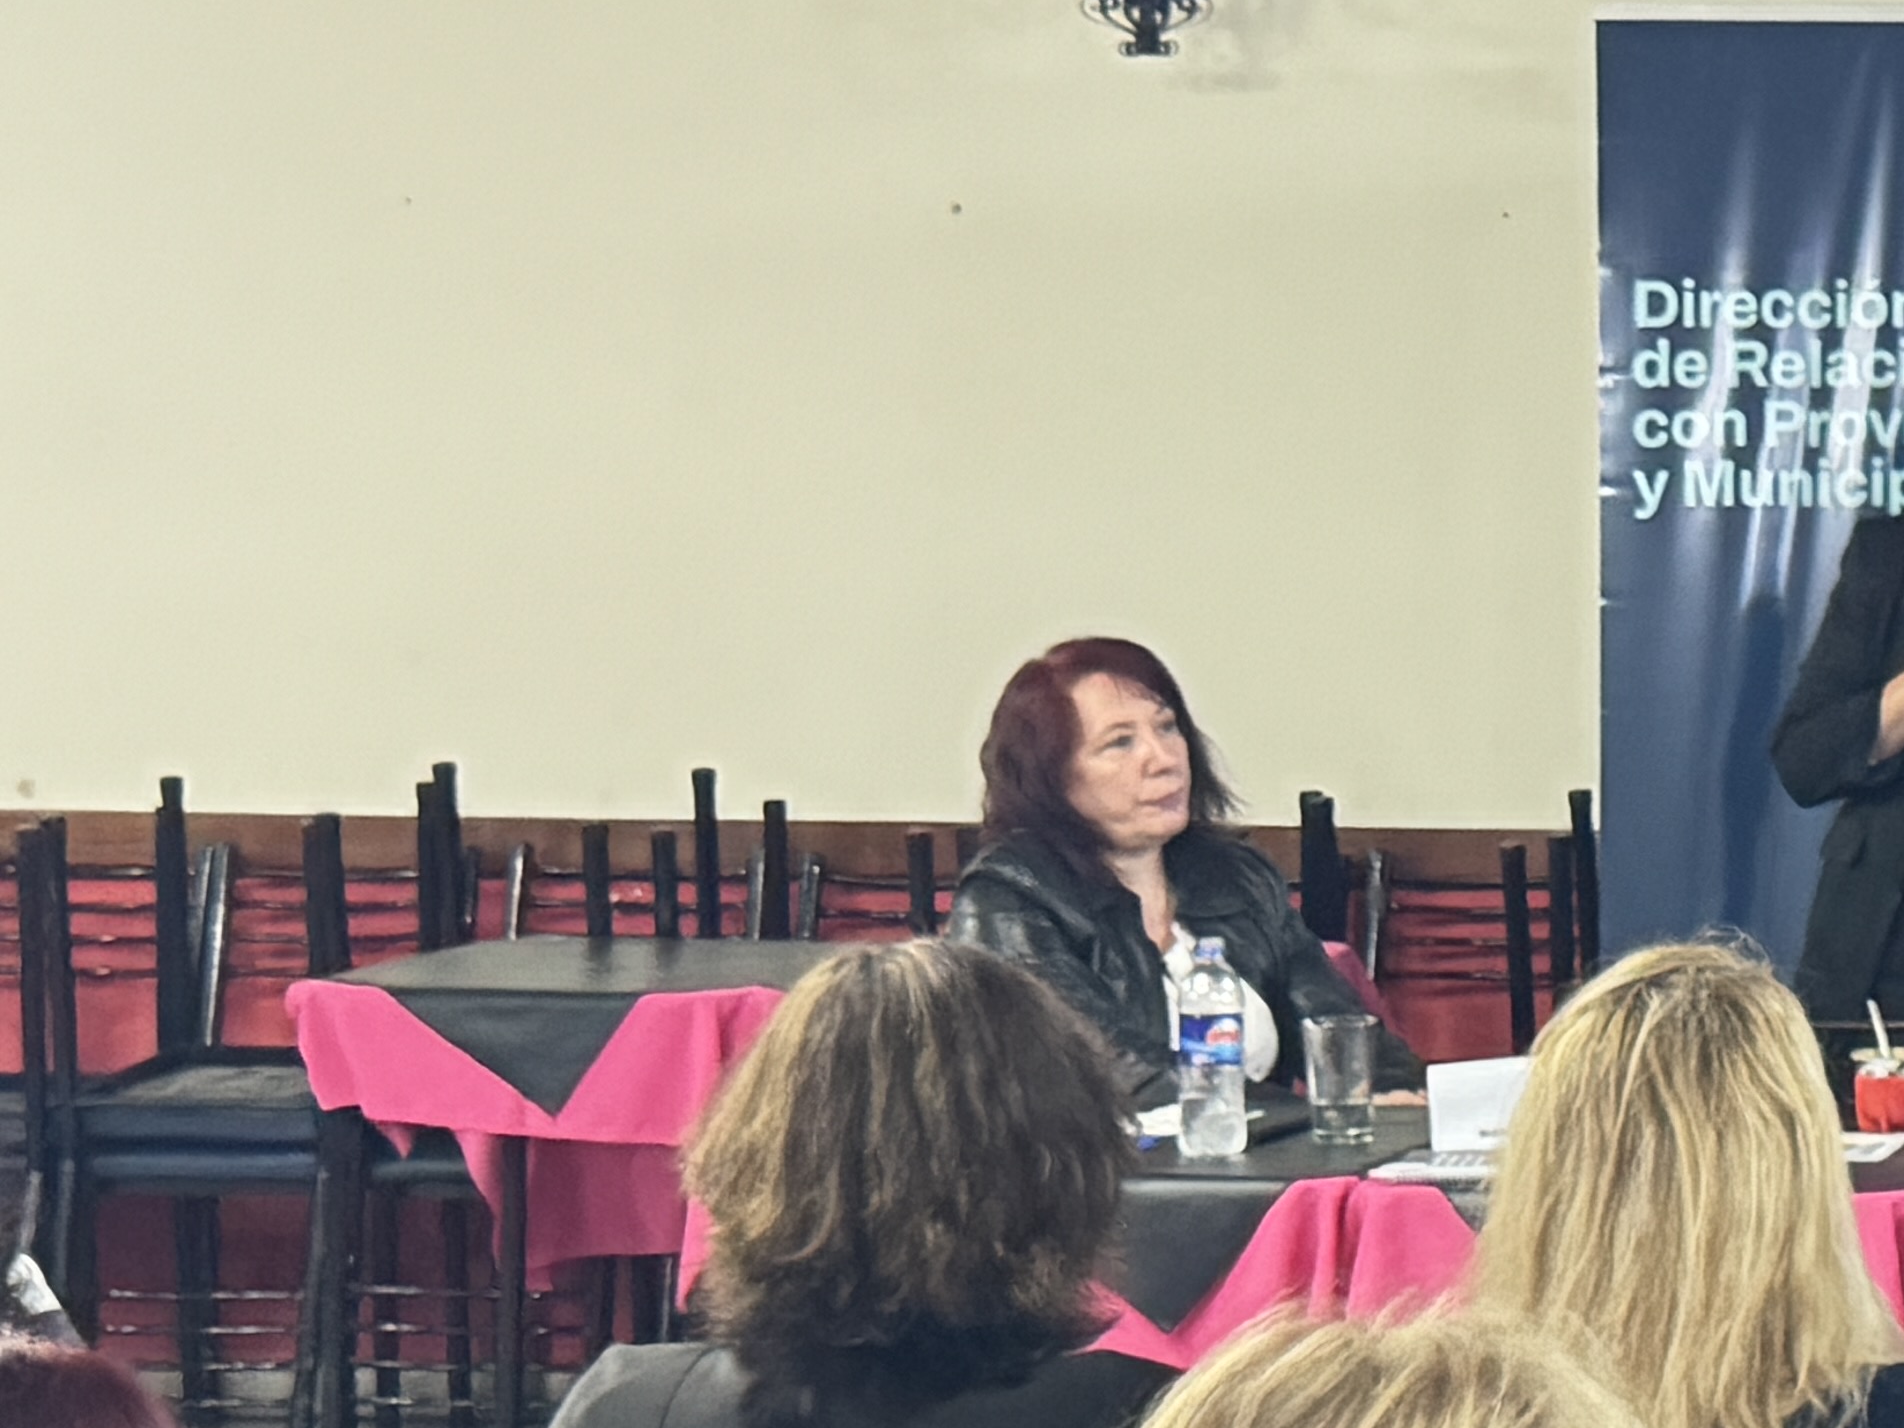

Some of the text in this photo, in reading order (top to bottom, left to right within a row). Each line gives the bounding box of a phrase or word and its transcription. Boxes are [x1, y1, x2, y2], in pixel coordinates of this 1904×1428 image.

[1632, 341, 1707, 388] de
[1632, 409, 1747, 448] con
[1633, 472, 1669, 519] y
